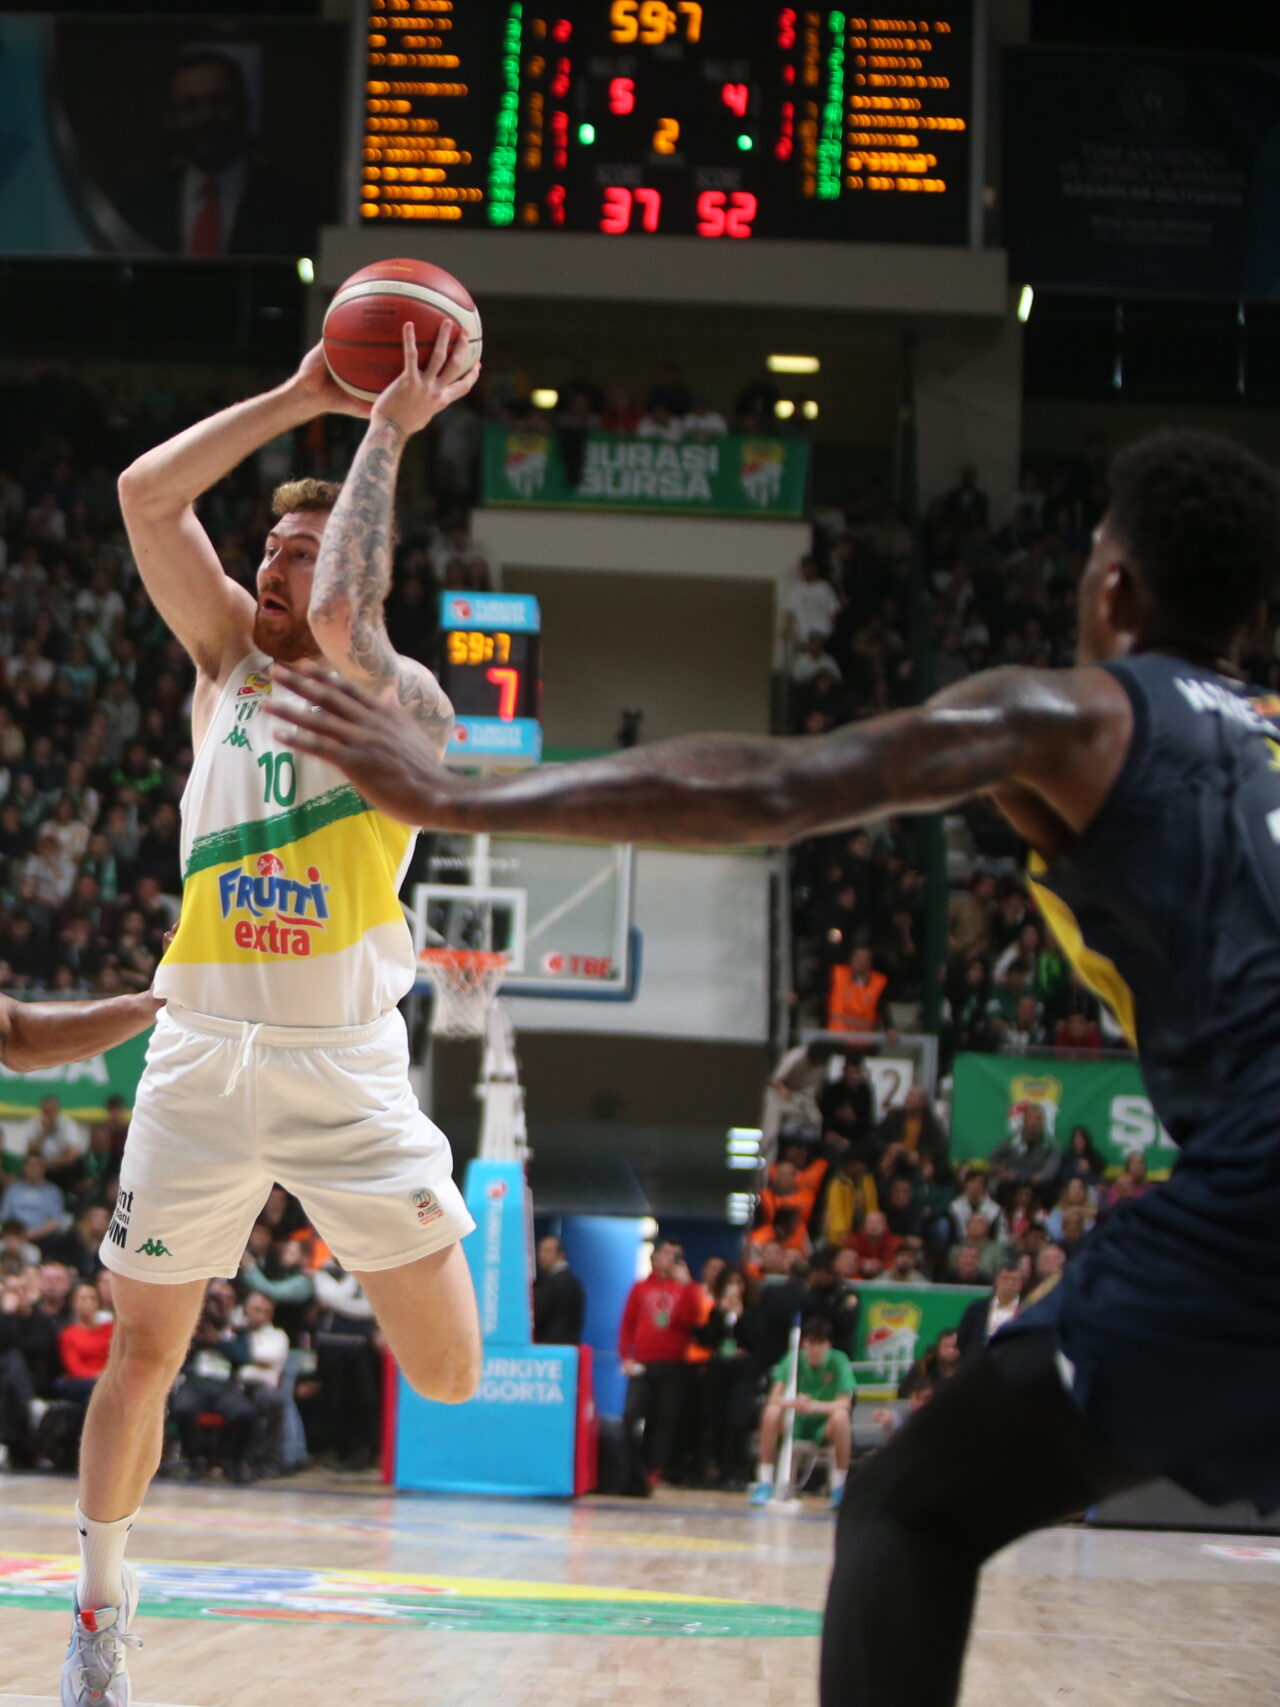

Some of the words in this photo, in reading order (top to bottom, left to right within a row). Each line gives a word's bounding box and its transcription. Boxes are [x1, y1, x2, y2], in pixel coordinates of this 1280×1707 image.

[722, 83, 749, 118] 4
[653, 117, 680, 155] 2
[600, 186, 661, 234] 37
[696, 190, 758, 239] 52
[486, 667, 519, 723] 7
[257, 751, 297, 807] 10
[235, 920, 311, 956] extra
